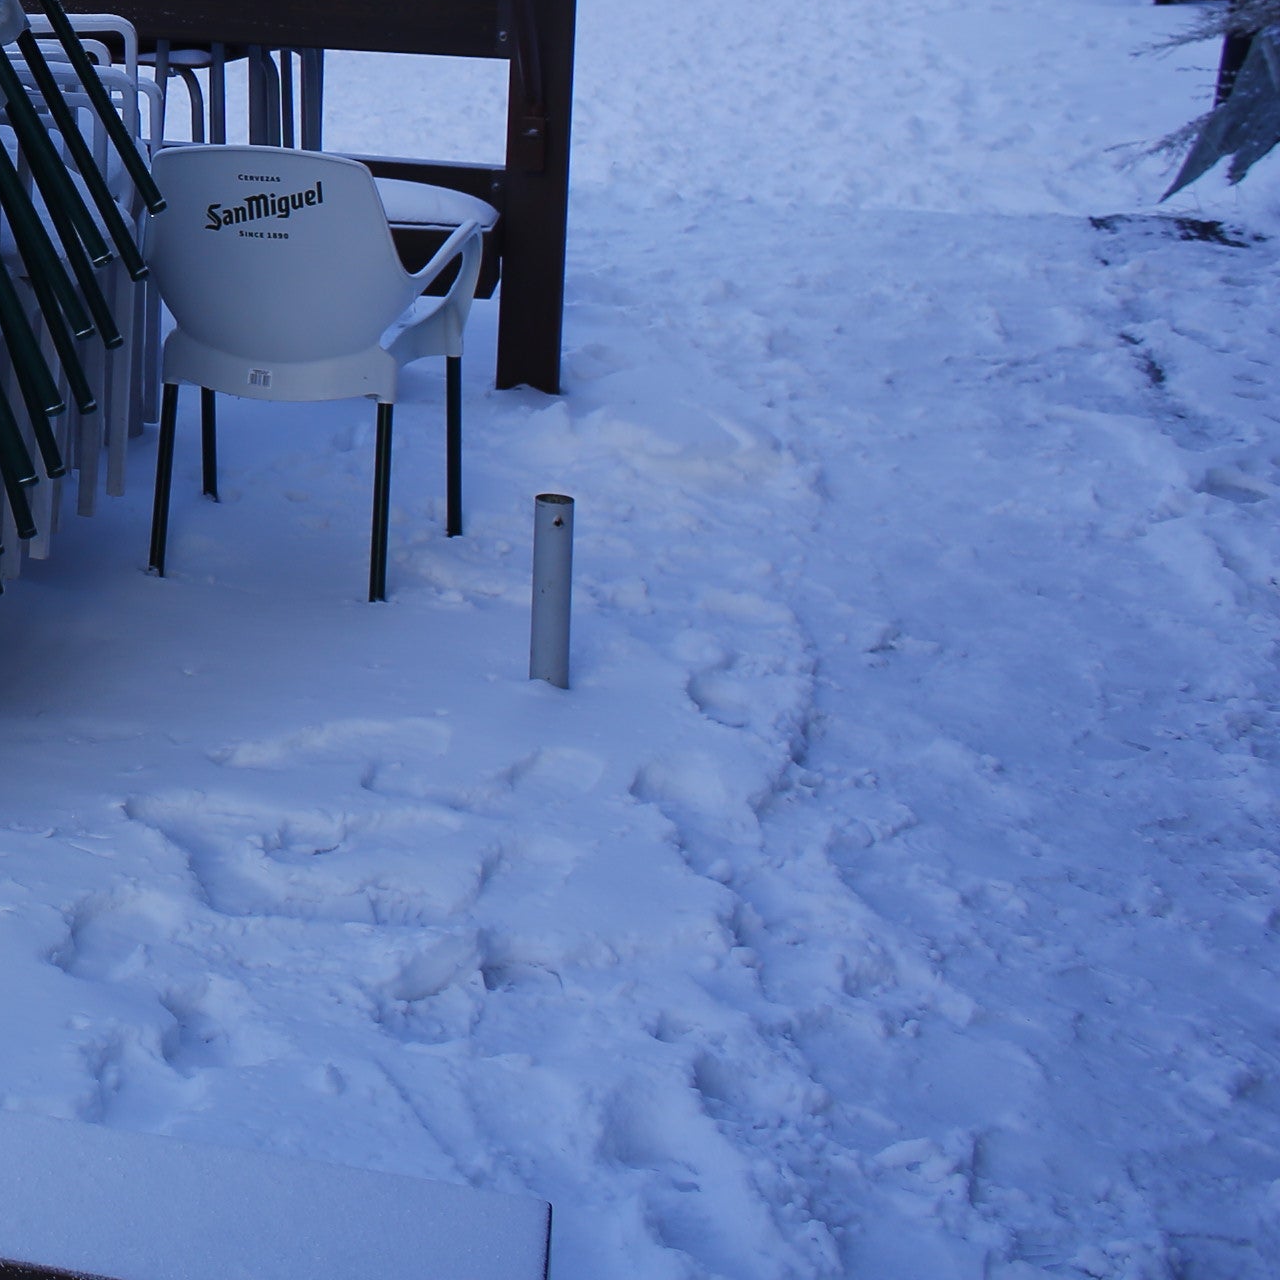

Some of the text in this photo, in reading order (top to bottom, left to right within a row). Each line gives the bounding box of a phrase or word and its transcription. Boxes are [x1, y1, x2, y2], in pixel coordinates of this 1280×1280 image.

[238, 174, 281, 183] CERVEZAS
[239, 230, 289, 239] SINCE 1890
